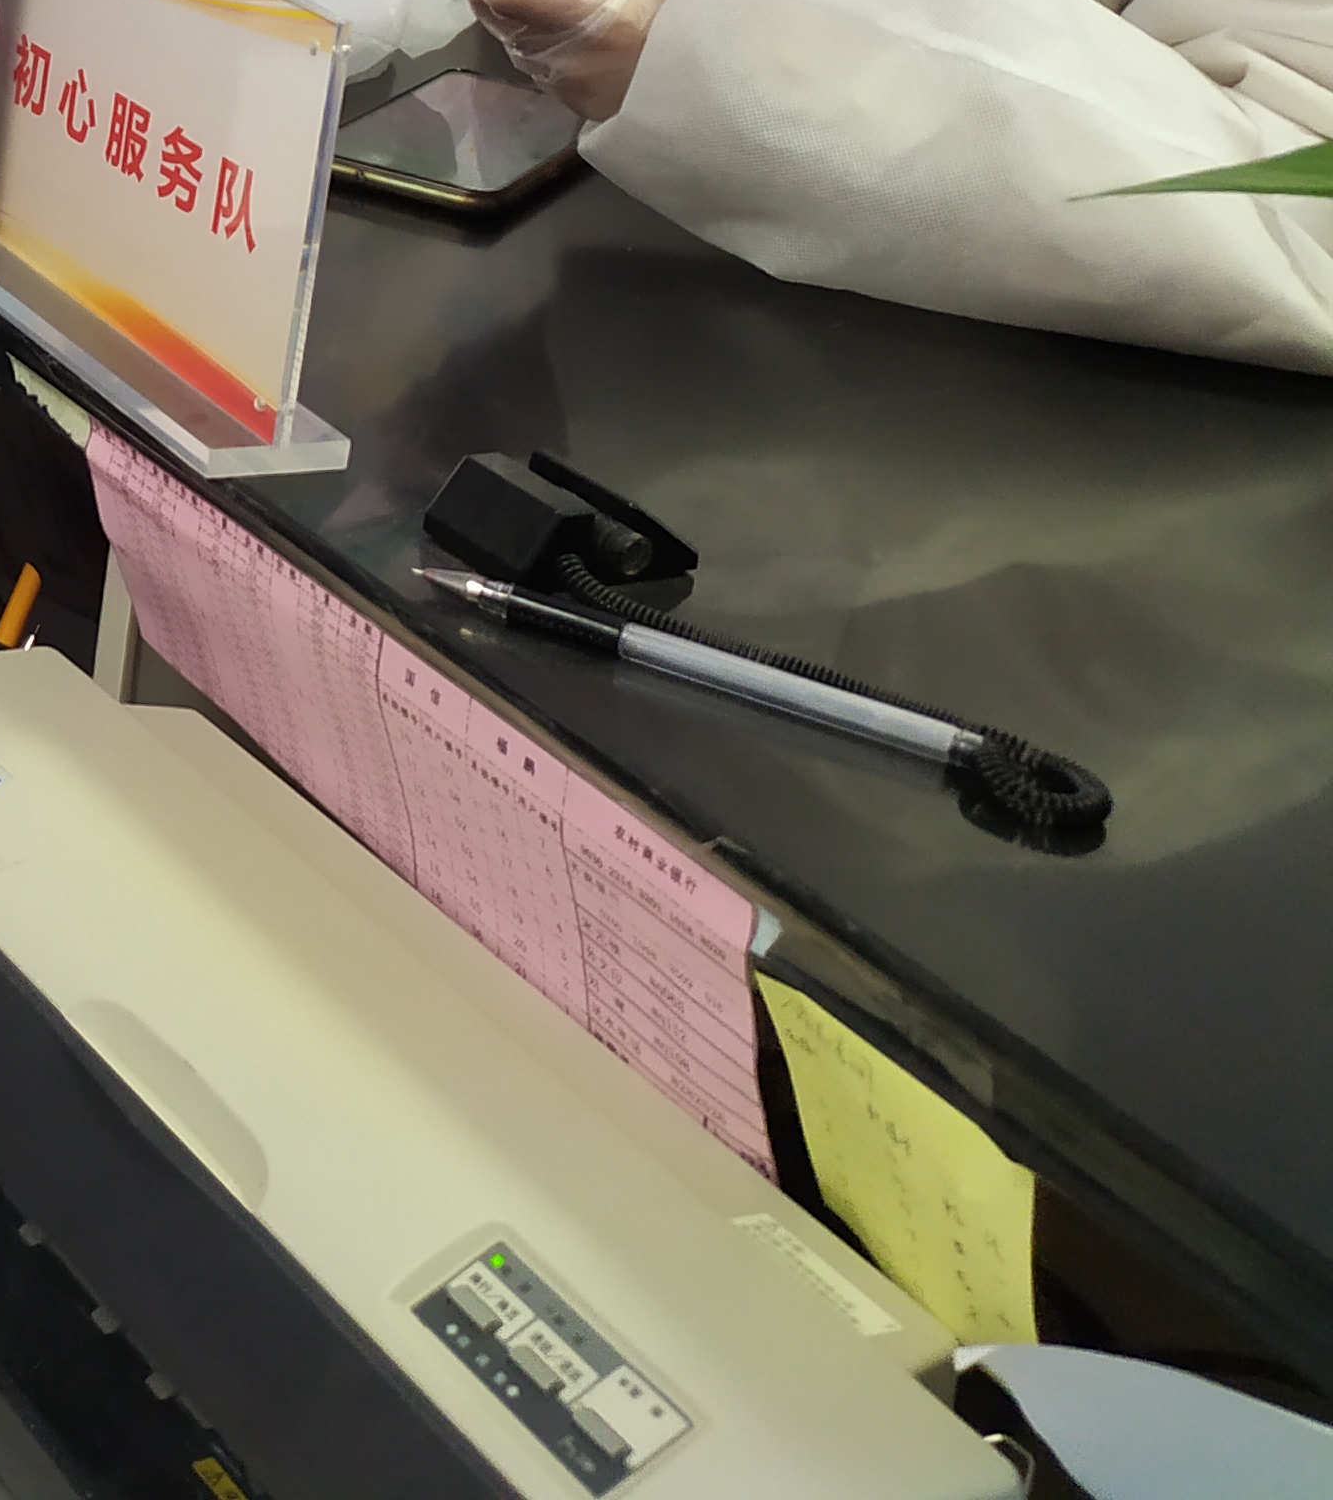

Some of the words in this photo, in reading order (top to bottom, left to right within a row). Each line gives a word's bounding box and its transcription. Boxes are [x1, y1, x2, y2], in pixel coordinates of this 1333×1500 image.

[13, 34, 257, 255] 初心服务队
